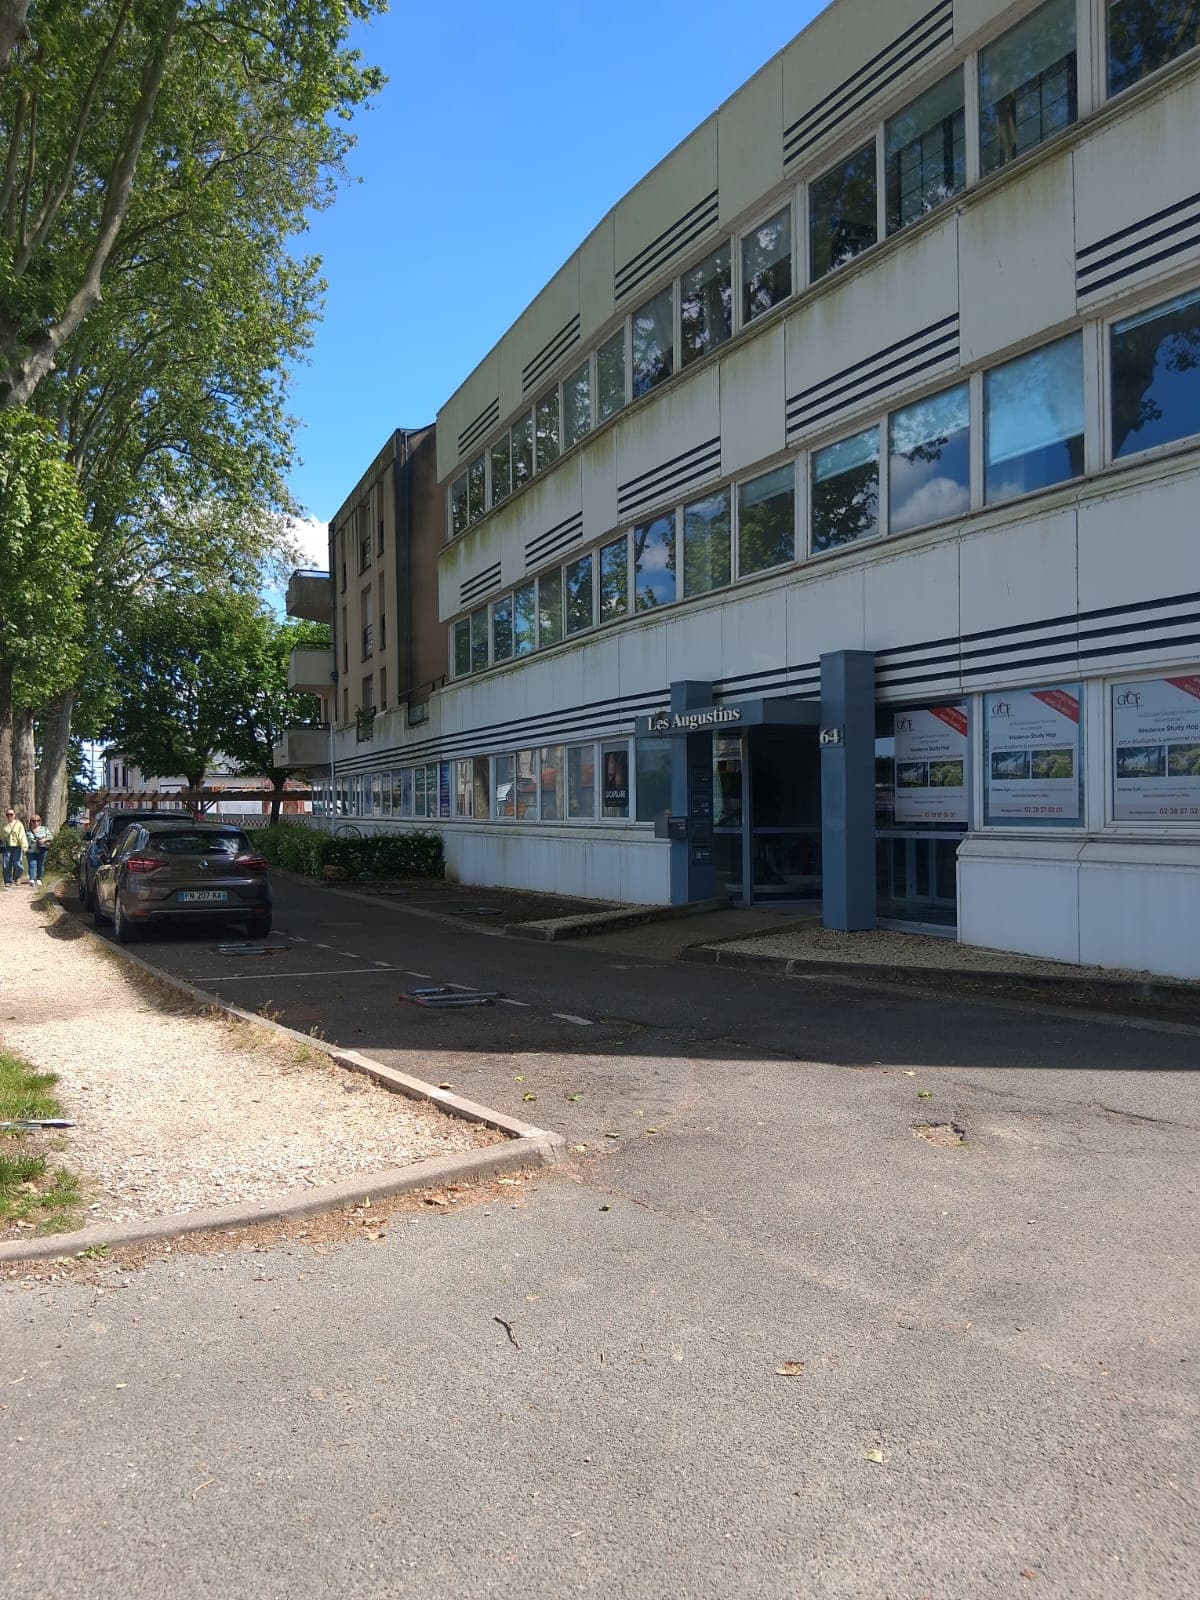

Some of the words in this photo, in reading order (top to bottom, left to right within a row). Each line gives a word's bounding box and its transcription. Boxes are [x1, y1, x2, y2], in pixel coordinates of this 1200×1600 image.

[647, 717, 670, 731] Les
[671, 707, 741, 730] Augustins
[1166, 724, 1185, 732] Study
[1186, 723, 1200, 731] Hop
[819, 728, 840, 744] 64
[1160, 807, 1168, 815] 02
